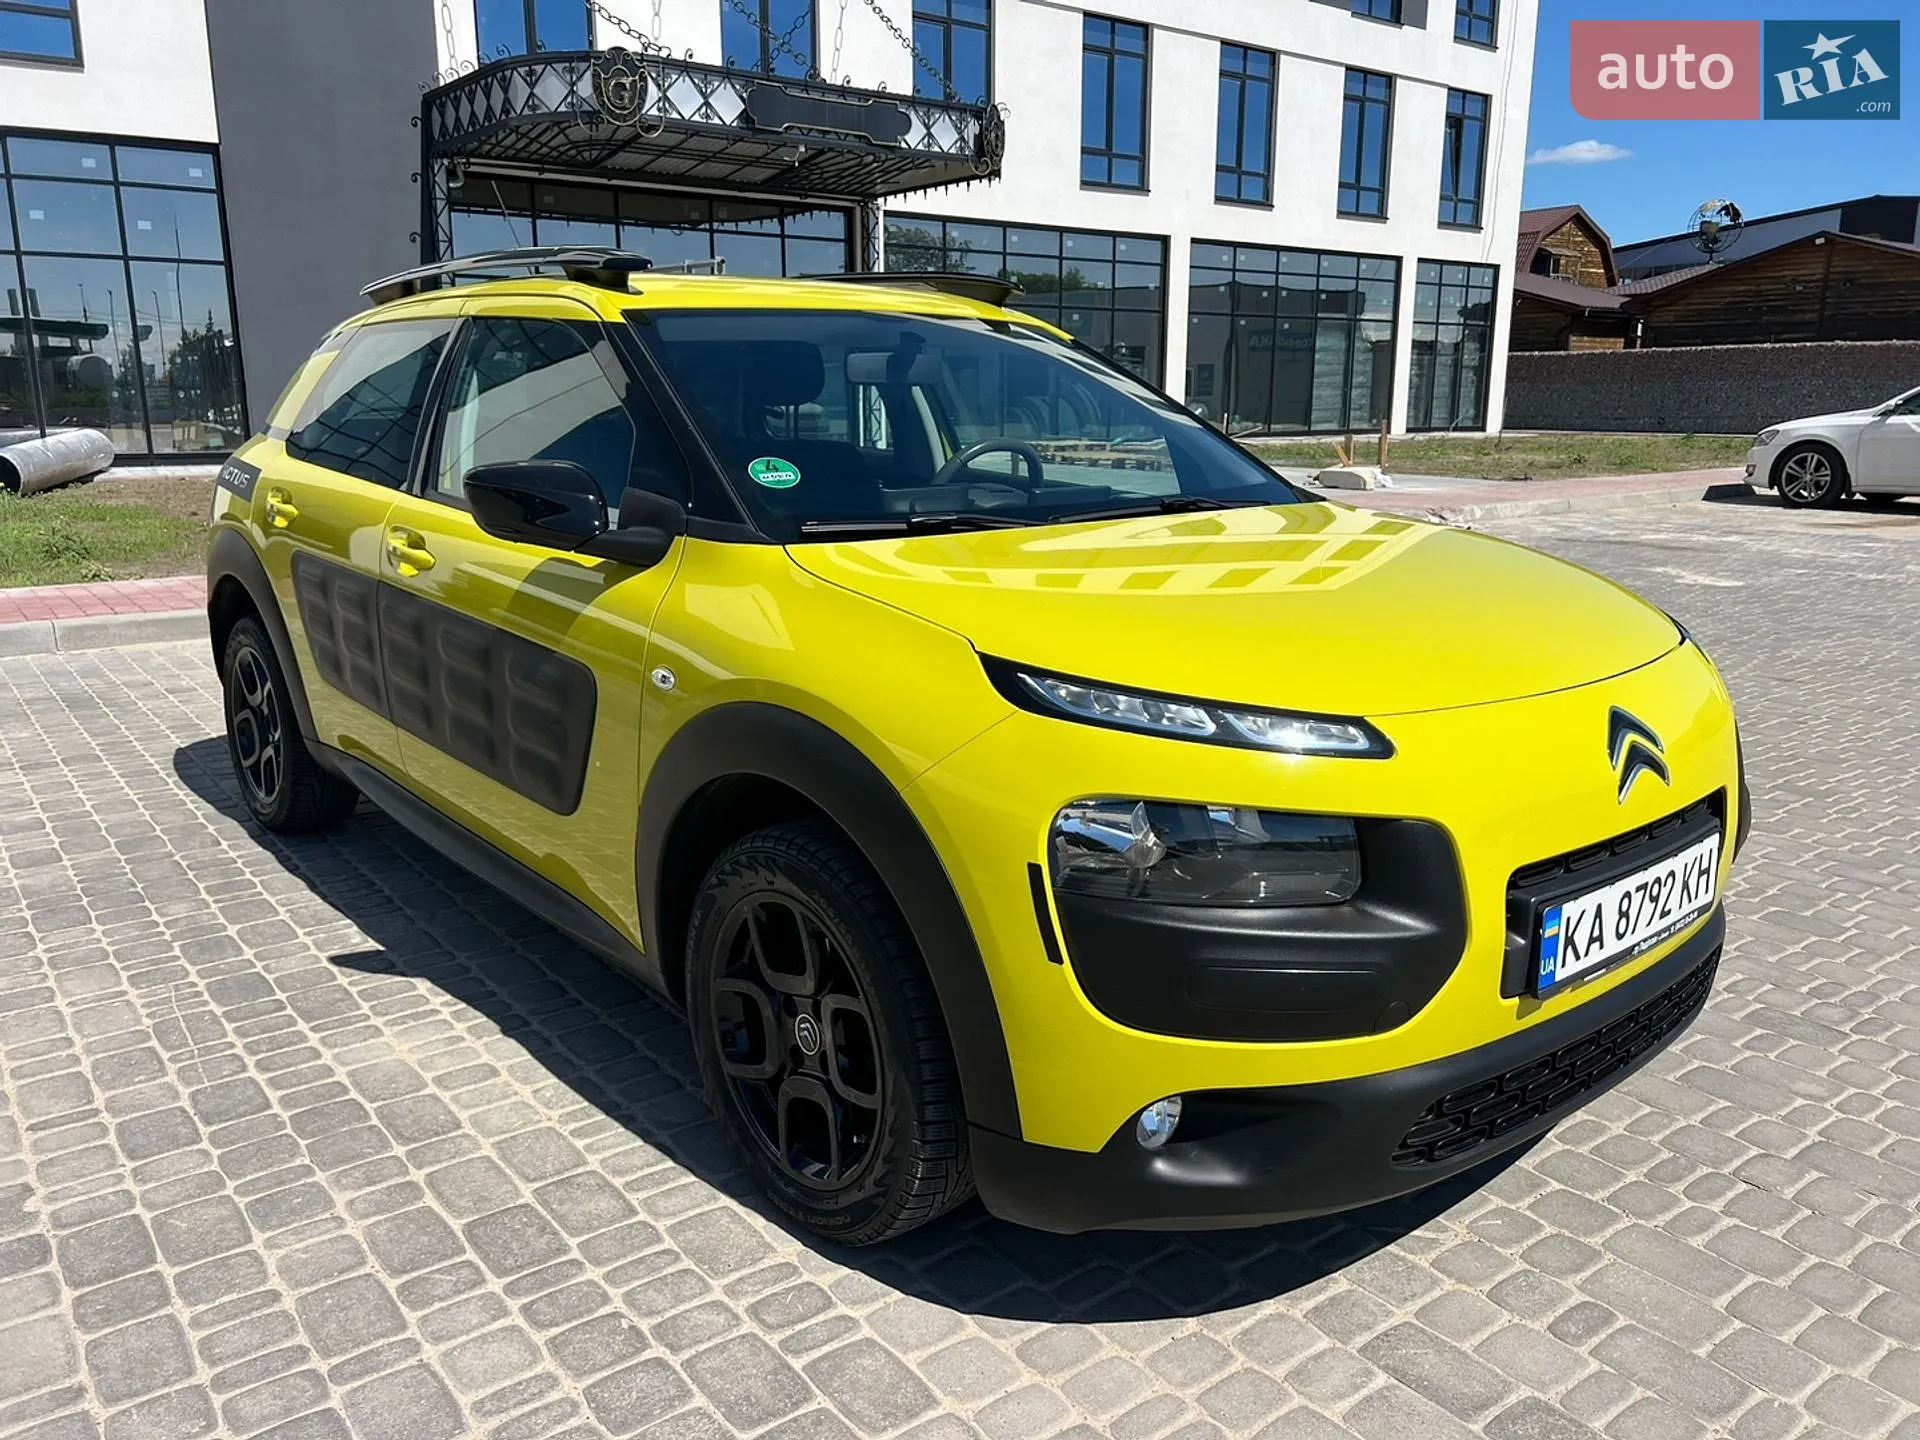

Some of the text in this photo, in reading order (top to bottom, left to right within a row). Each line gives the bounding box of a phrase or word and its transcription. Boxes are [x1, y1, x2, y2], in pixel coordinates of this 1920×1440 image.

[1561, 903, 1605, 969] KA
[1615, 869, 1676, 941] 8792
[1679, 849, 1713, 909] KH
[1541, 956, 1555, 975] UA
